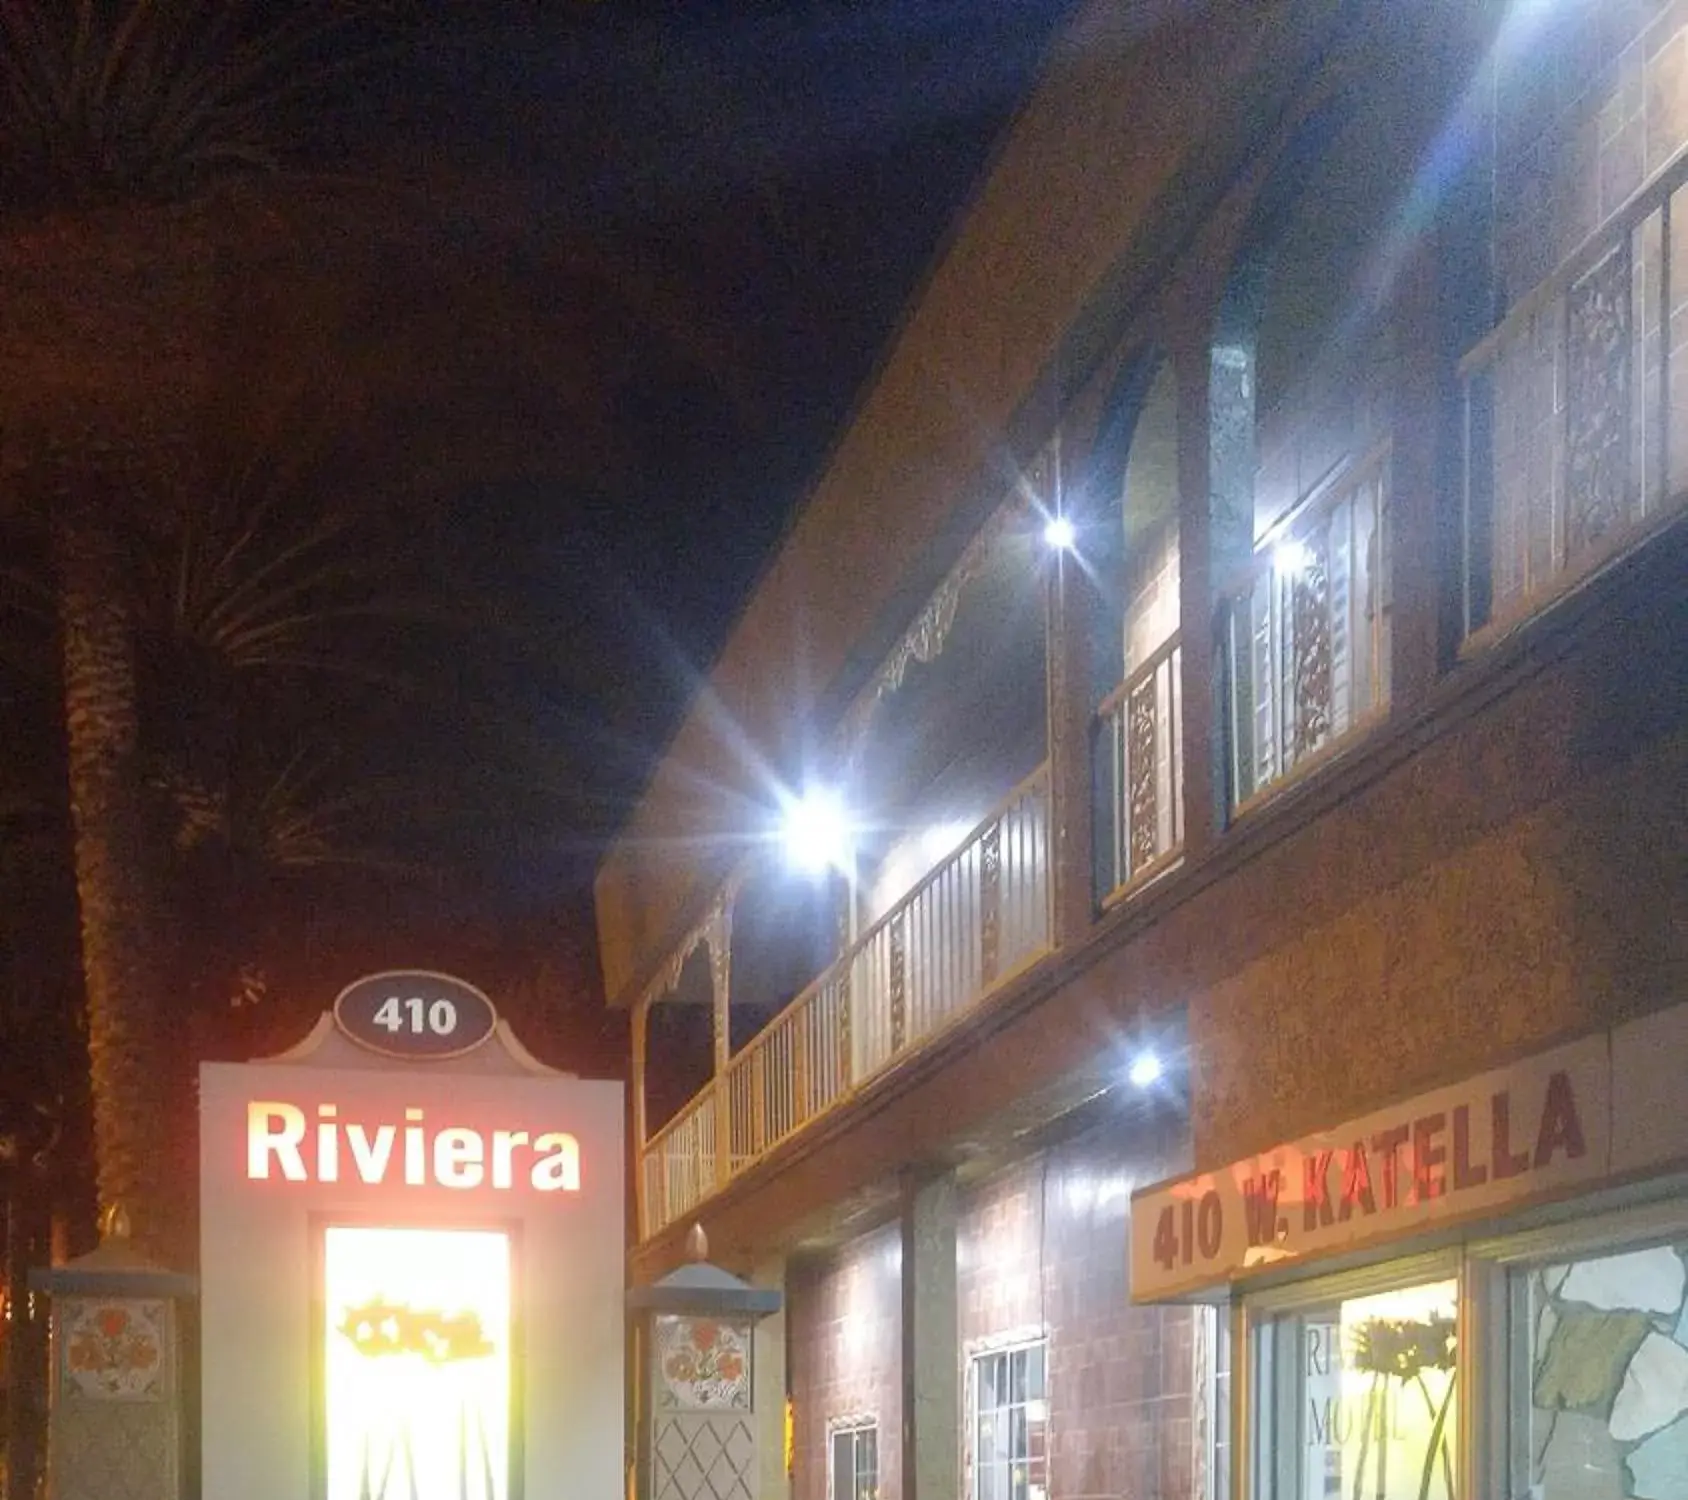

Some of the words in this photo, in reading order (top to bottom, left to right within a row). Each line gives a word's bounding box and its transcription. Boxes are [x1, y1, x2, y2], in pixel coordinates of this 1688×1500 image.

[373, 997, 457, 1036] 410
[246, 1101, 581, 1191] Riviera
[1153, 1191, 1222, 1270] 410
[1303, 1069, 1587, 1232] KATELLA
